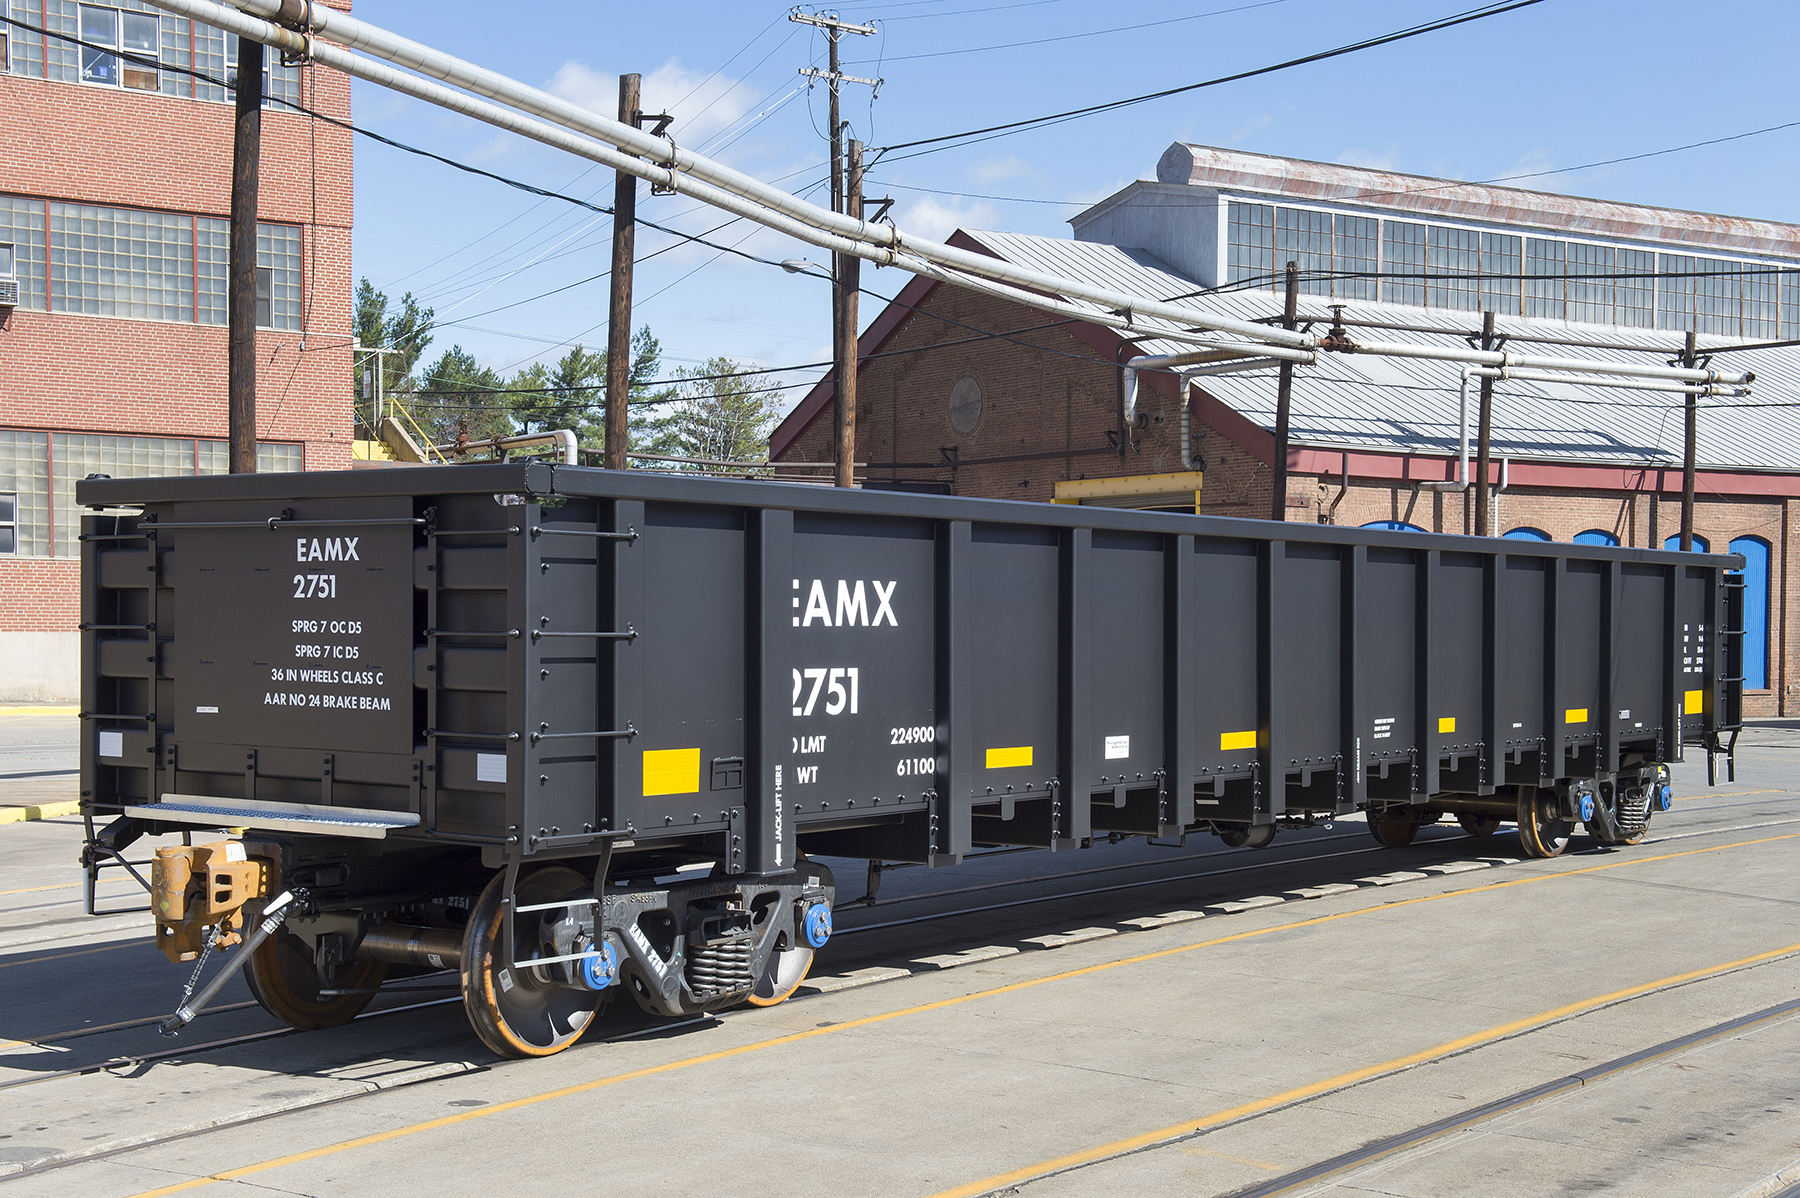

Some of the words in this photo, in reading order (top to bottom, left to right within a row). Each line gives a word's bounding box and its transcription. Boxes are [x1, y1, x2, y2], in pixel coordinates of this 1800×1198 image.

[297, 537, 360, 562] EAMX
[293, 574, 336, 599] 2751
[291, 619, 318, 633] SPRG
[320, 620, 328, 633] 7
[329, 620, 346, 634] OC
[348, 621, 362, 634] D5
[295, 644, 322, 658] SPRG
[323, 645, 331, 658] 7
[333, 645, 343, 659] IC
[345, 646, 359, 659] D5
[271, 668, 284, 681] 36
[286, 668, 298, 682] IN
[299, 669, 339, 684] WHEELS
[341, 670, 374, 685] CLASS
[375, 672, 384, 686] C
[264, 692, 287, 706] AAR
[289, 693, 306, 707] NO
[308, 694, 321, 707] 24
[323, 694, 358, 709] BRAKE
[359, 696, 391, 711] BEAM
[800, 735, 827, 754] LMT
[890, 725, 935, 745] 224900
[775, 764, 783, 791] HERE
[796, 765, 819, 784] WT
[896, 757, 935, 777] 61100
[774, 792, 783, 842] JACK-LIFT
[447, 896, 470, 910] 2751
[648, 950, 668, 978] 2751
